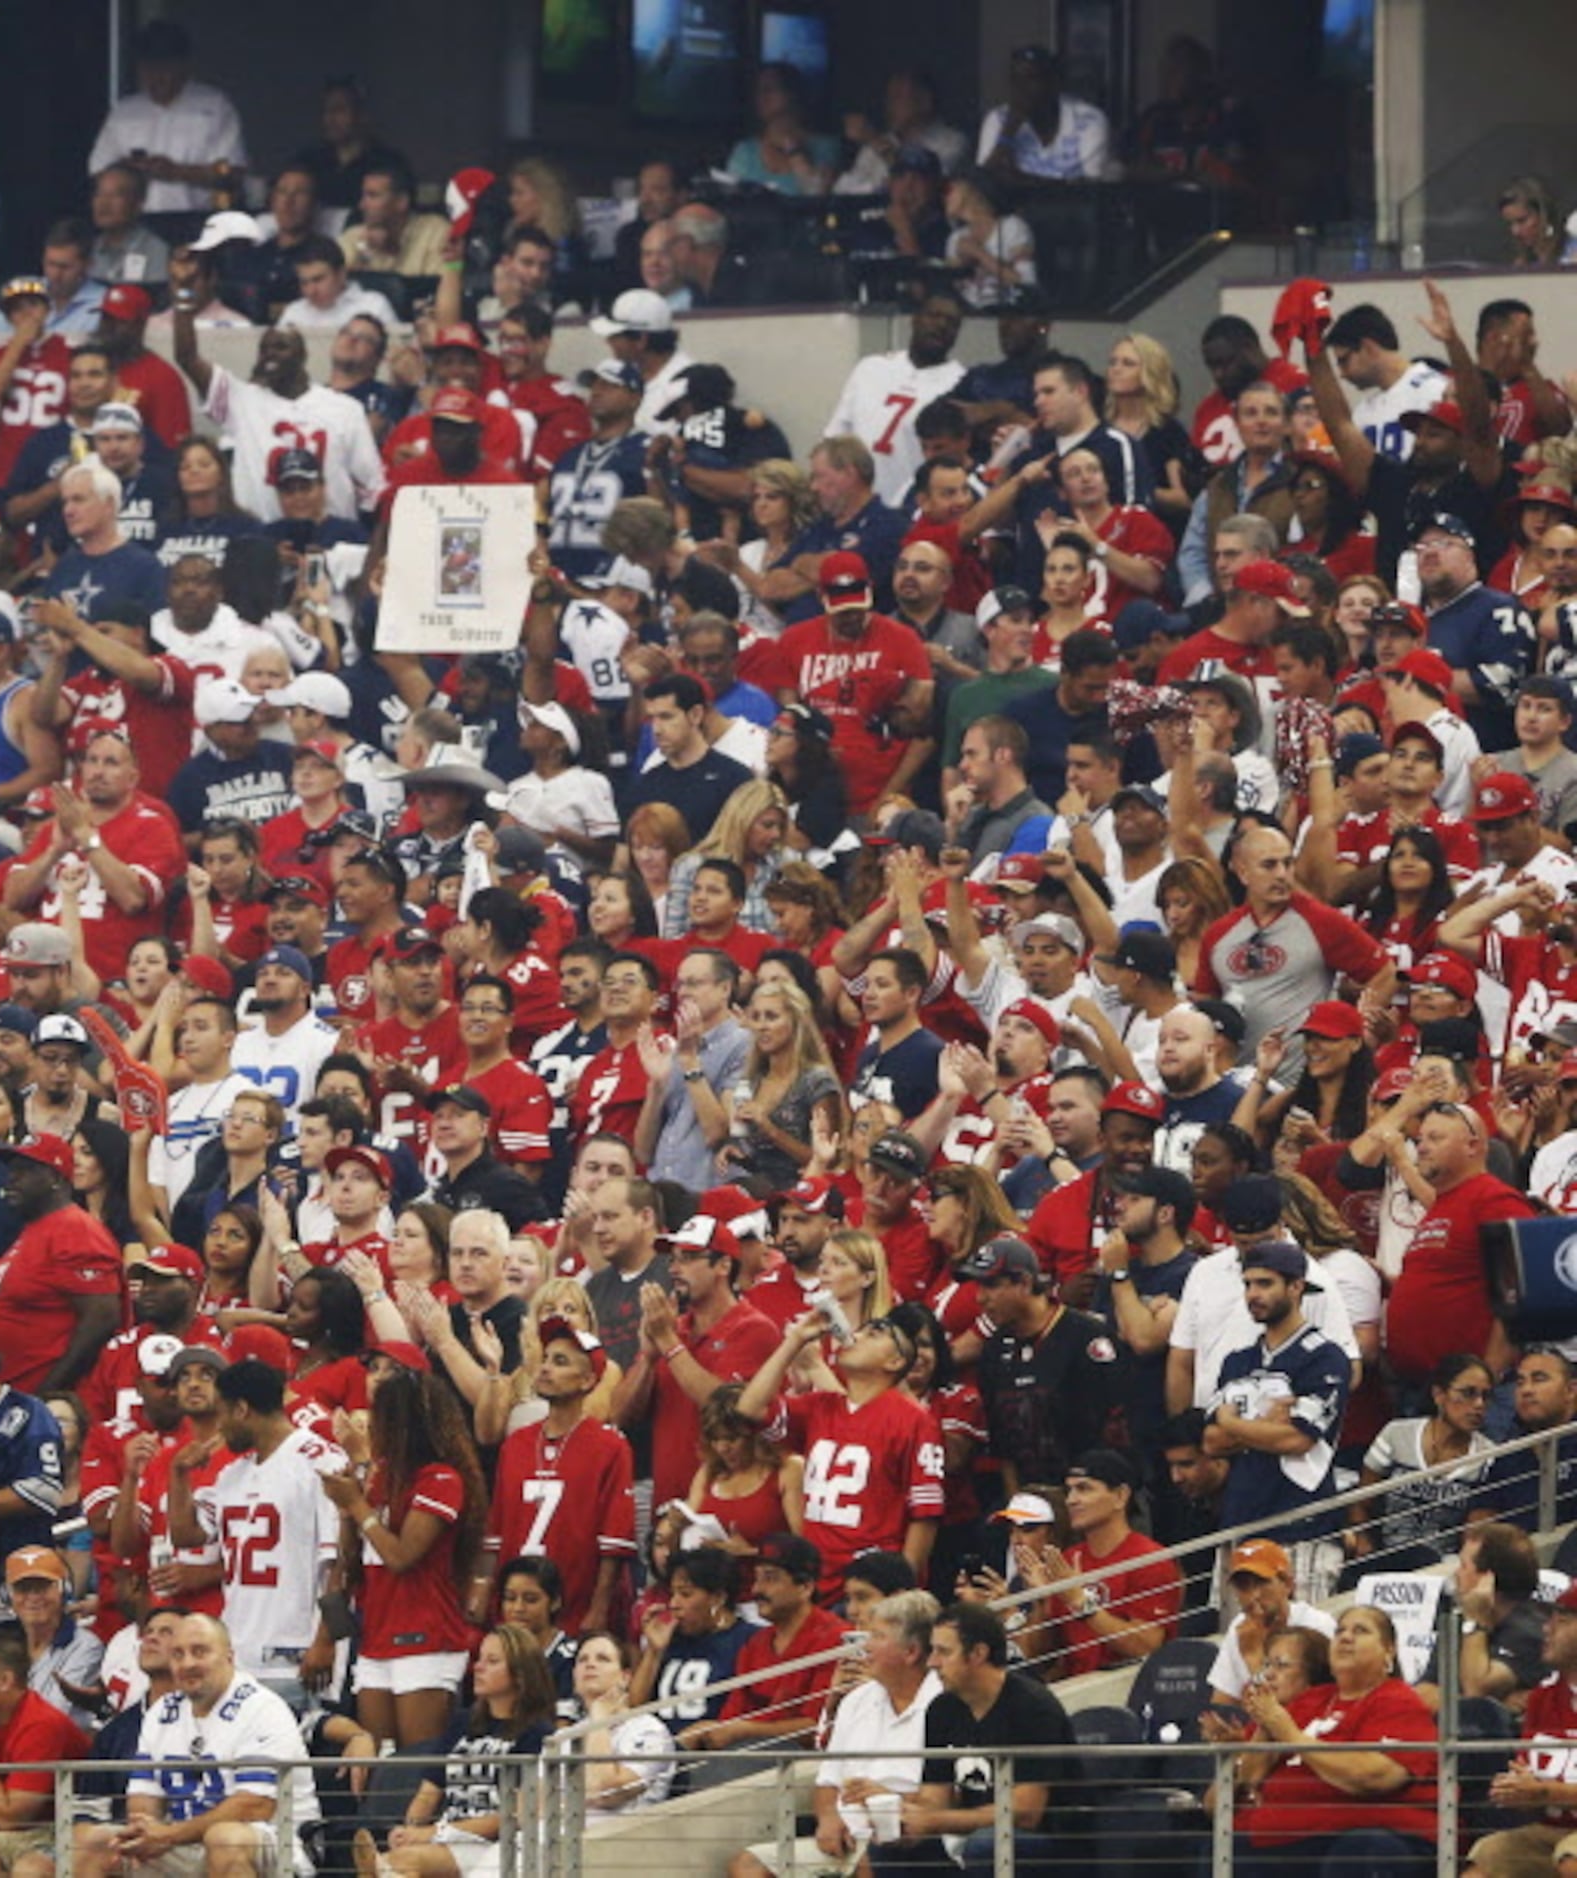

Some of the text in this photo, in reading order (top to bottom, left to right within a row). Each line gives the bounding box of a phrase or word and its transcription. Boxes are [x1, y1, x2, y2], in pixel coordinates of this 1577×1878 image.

[3, 372, 67, 427] 52
[872, 394, 917, 455] 7
[206, 771, 285, 804] DALLAS
[591, 1074, 622, 1135] 7
[38, 1442, 61, 1473] 9
[804, 1440, 871, 1528] 42
[223, 1503, 281, 1588] 52
[522, 1479, 564, 1557] 7
